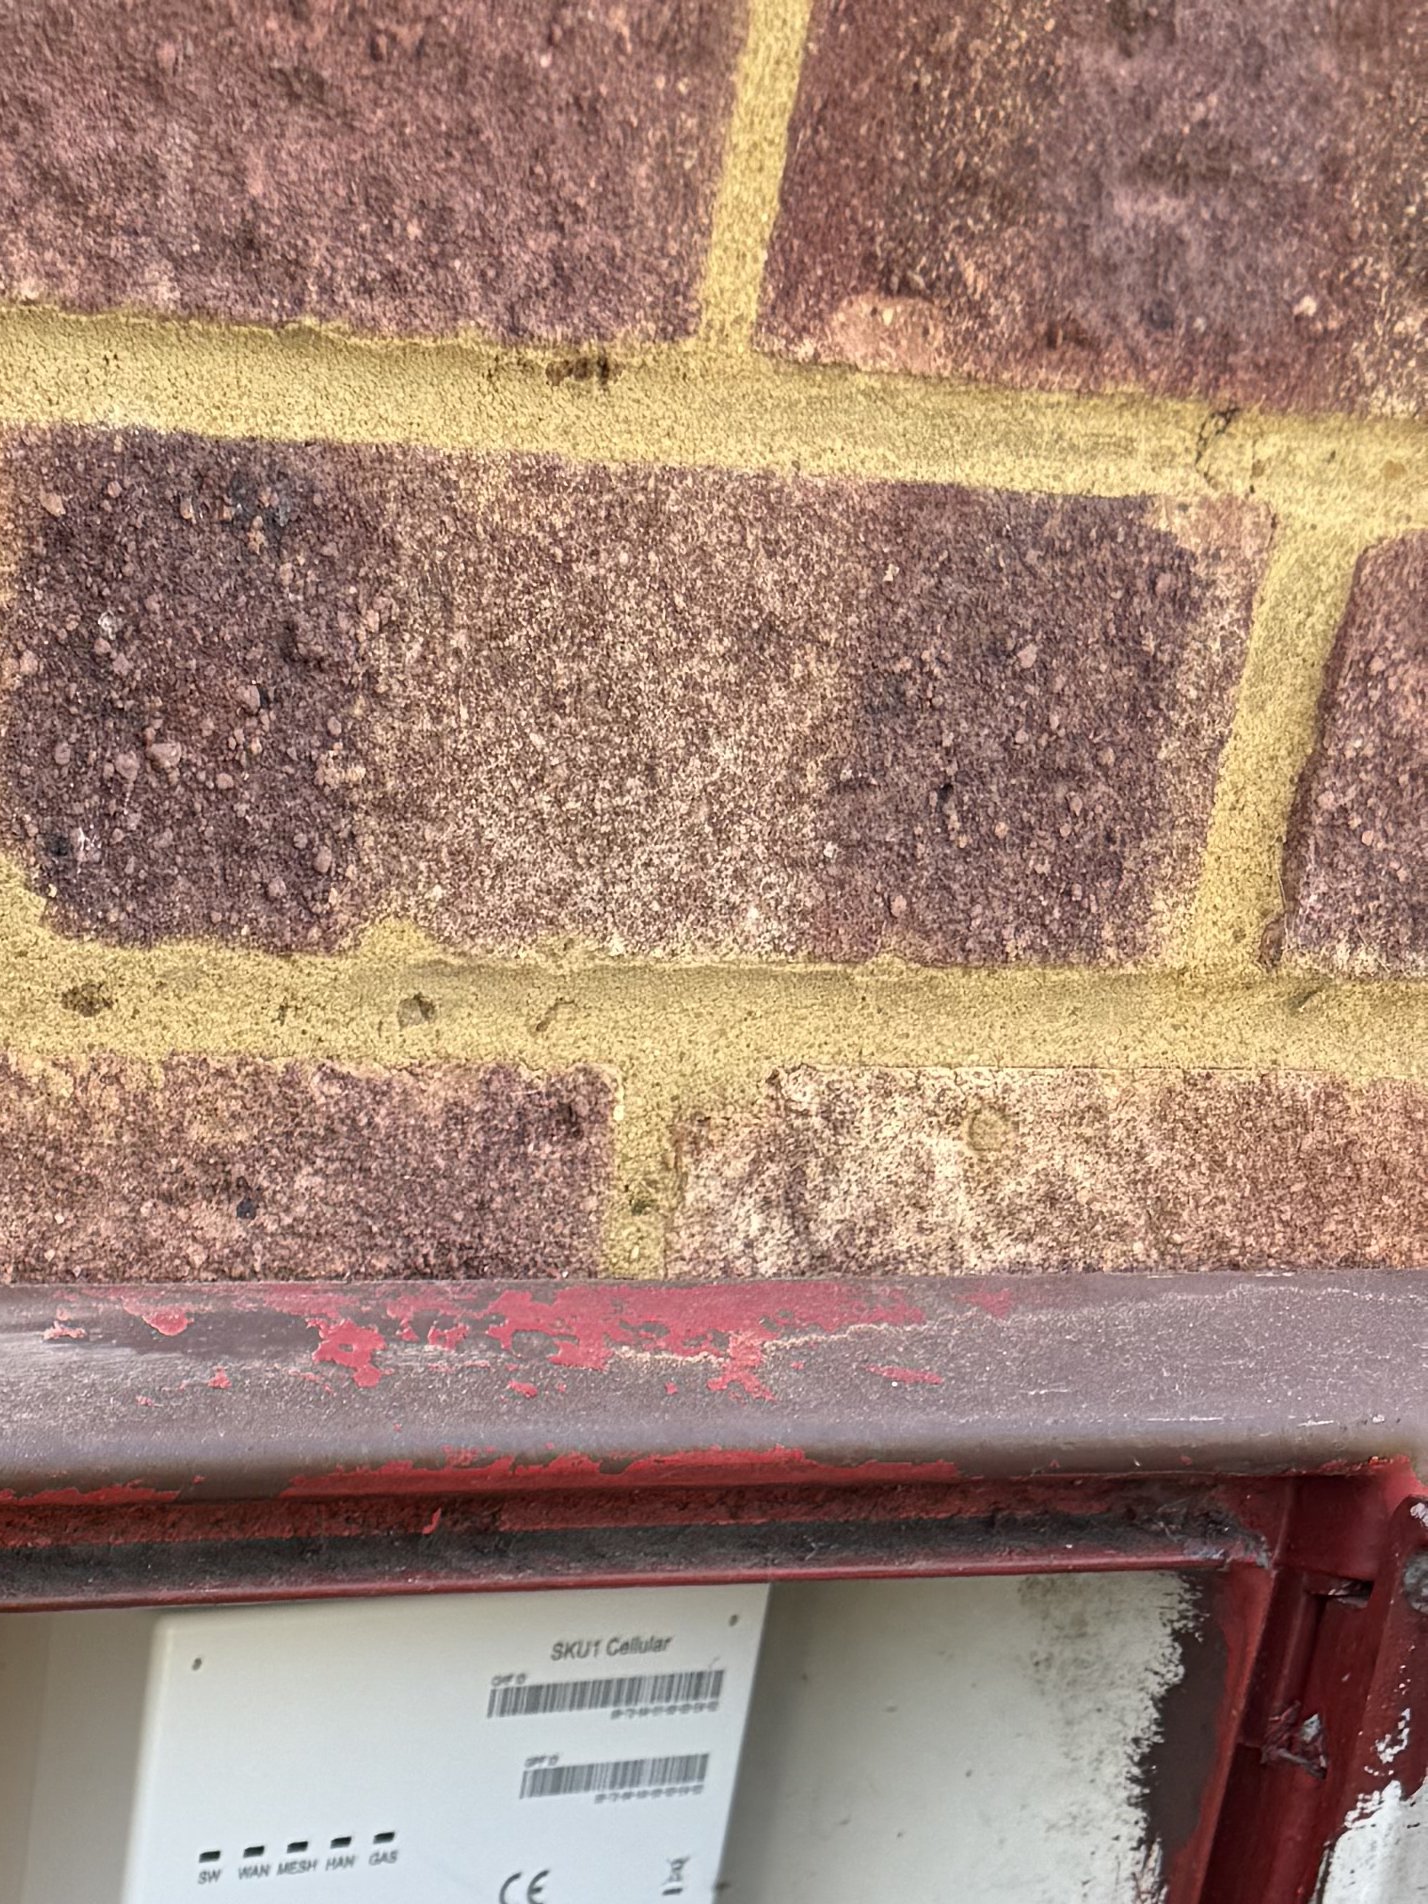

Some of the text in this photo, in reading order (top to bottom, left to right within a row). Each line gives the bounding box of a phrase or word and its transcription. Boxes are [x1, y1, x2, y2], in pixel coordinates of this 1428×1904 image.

[550, 1635, 673, 1661] SKU1 Cellular
[238, 1863, 271, 1880] WAN
[276, 1858, 318, 1876] MESH
[325, 1855, 356, 1871] HAN
[368, 1849, 398, 1866] GAS
